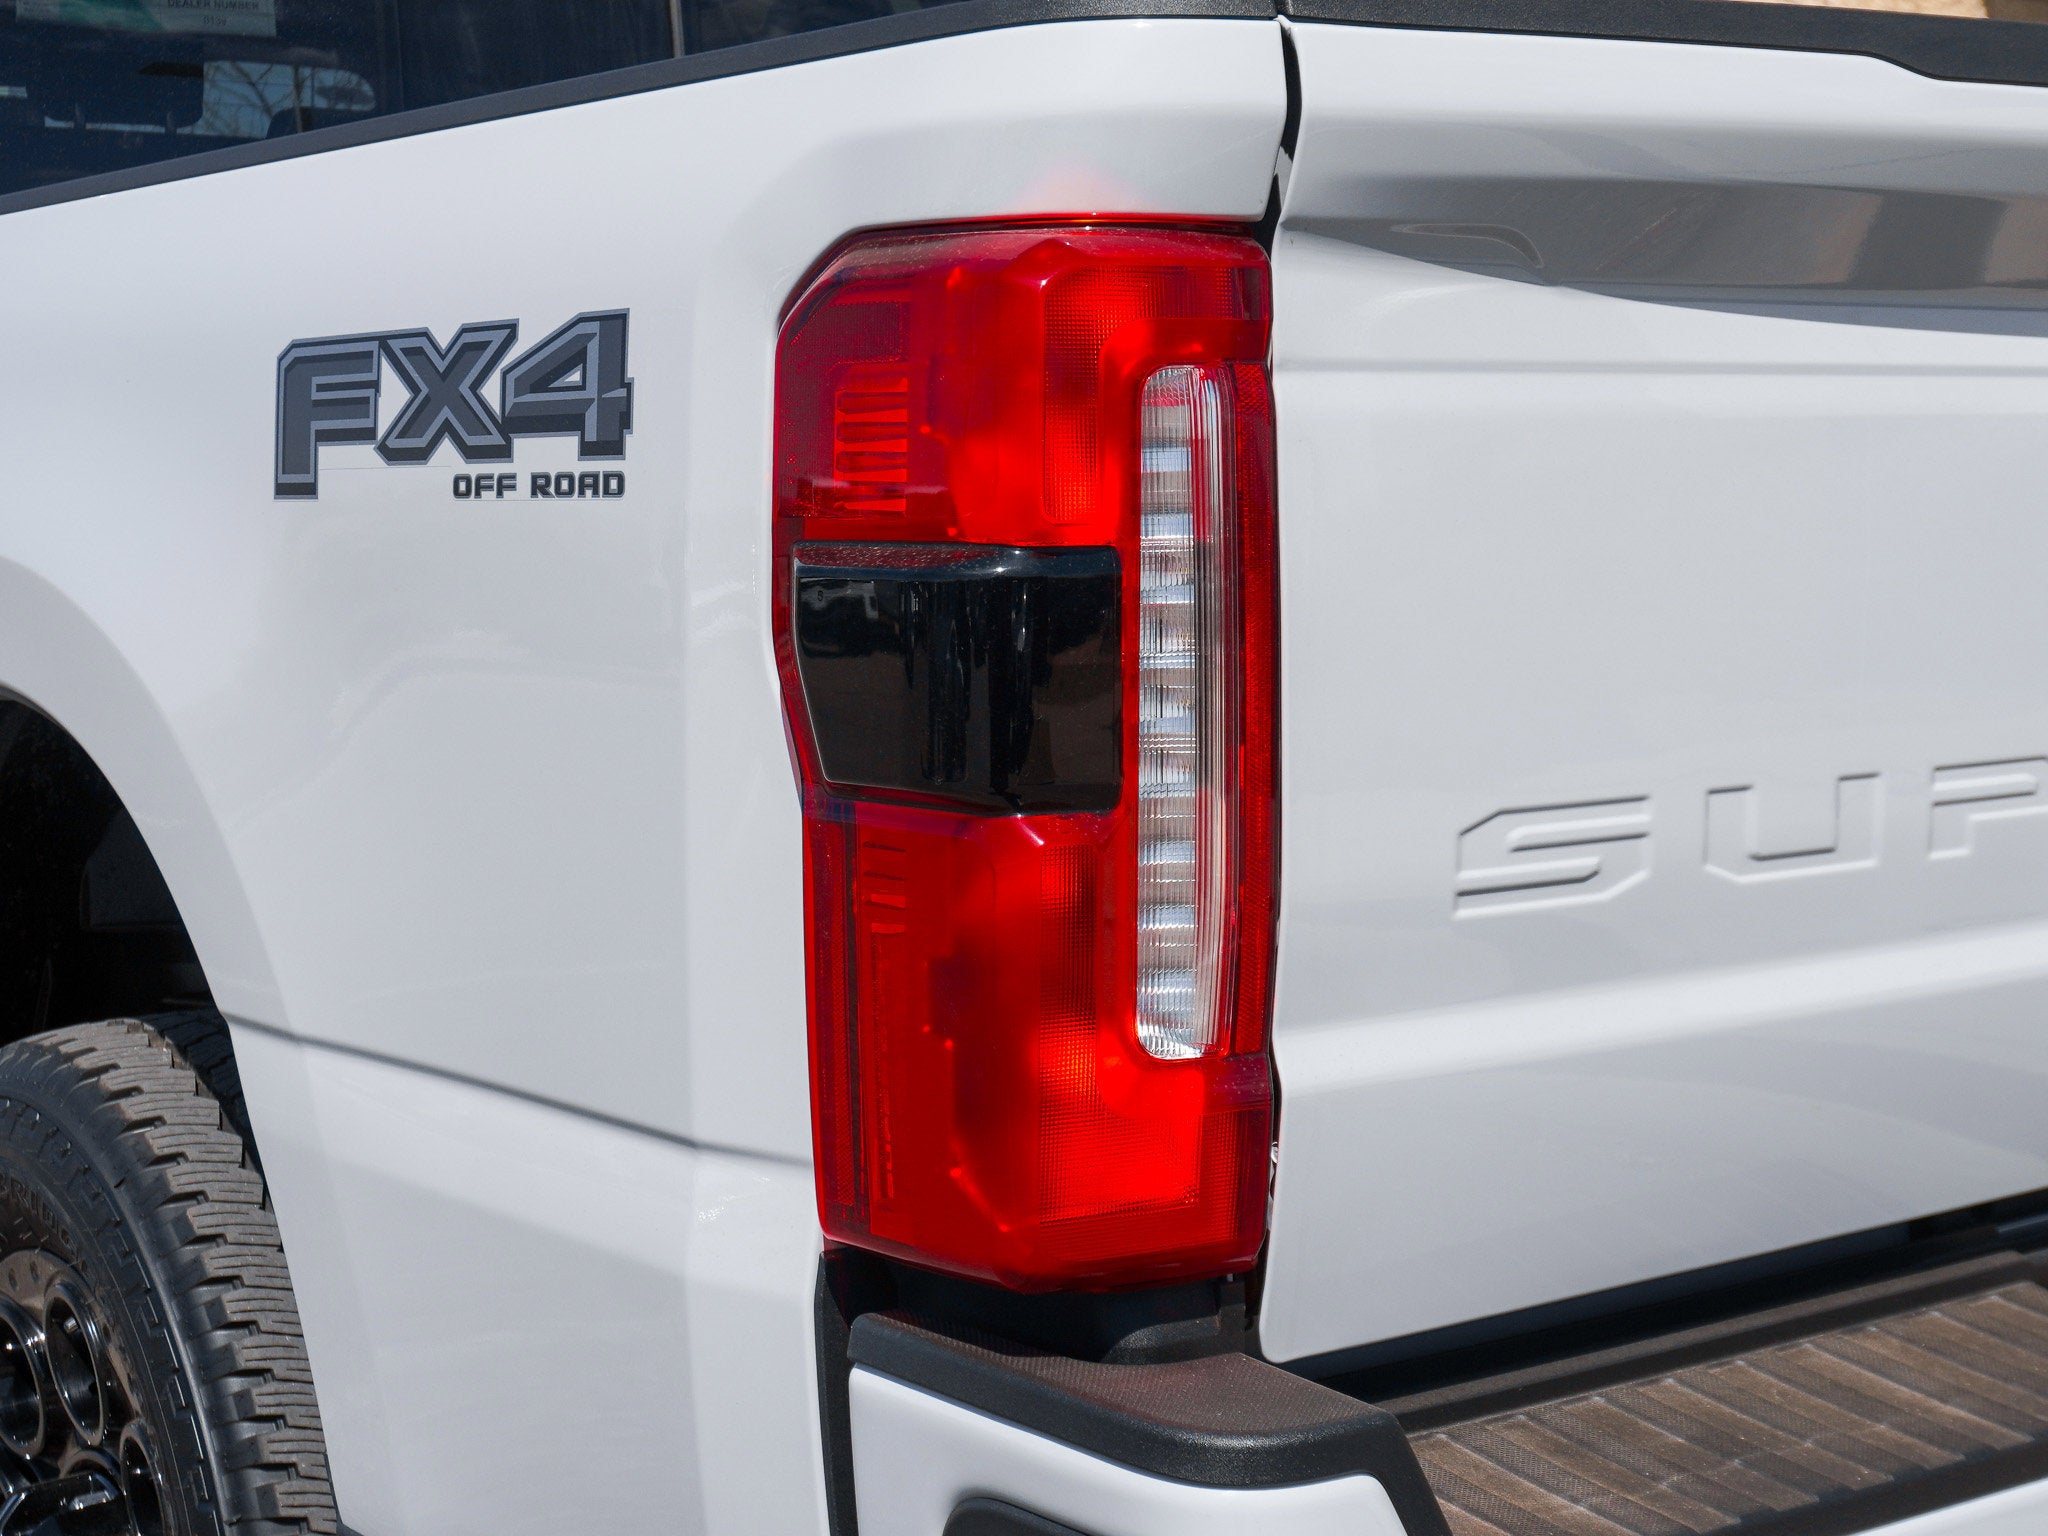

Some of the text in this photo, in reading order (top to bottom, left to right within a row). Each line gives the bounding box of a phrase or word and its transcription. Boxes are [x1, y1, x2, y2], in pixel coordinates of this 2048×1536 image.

[213, 0, 260, 10] NUMBER
[273, 307, 635, 500] FX4
[452, 470, 626, 499] OFF ROAD
[1452, 755, 2048, 921] SUP
